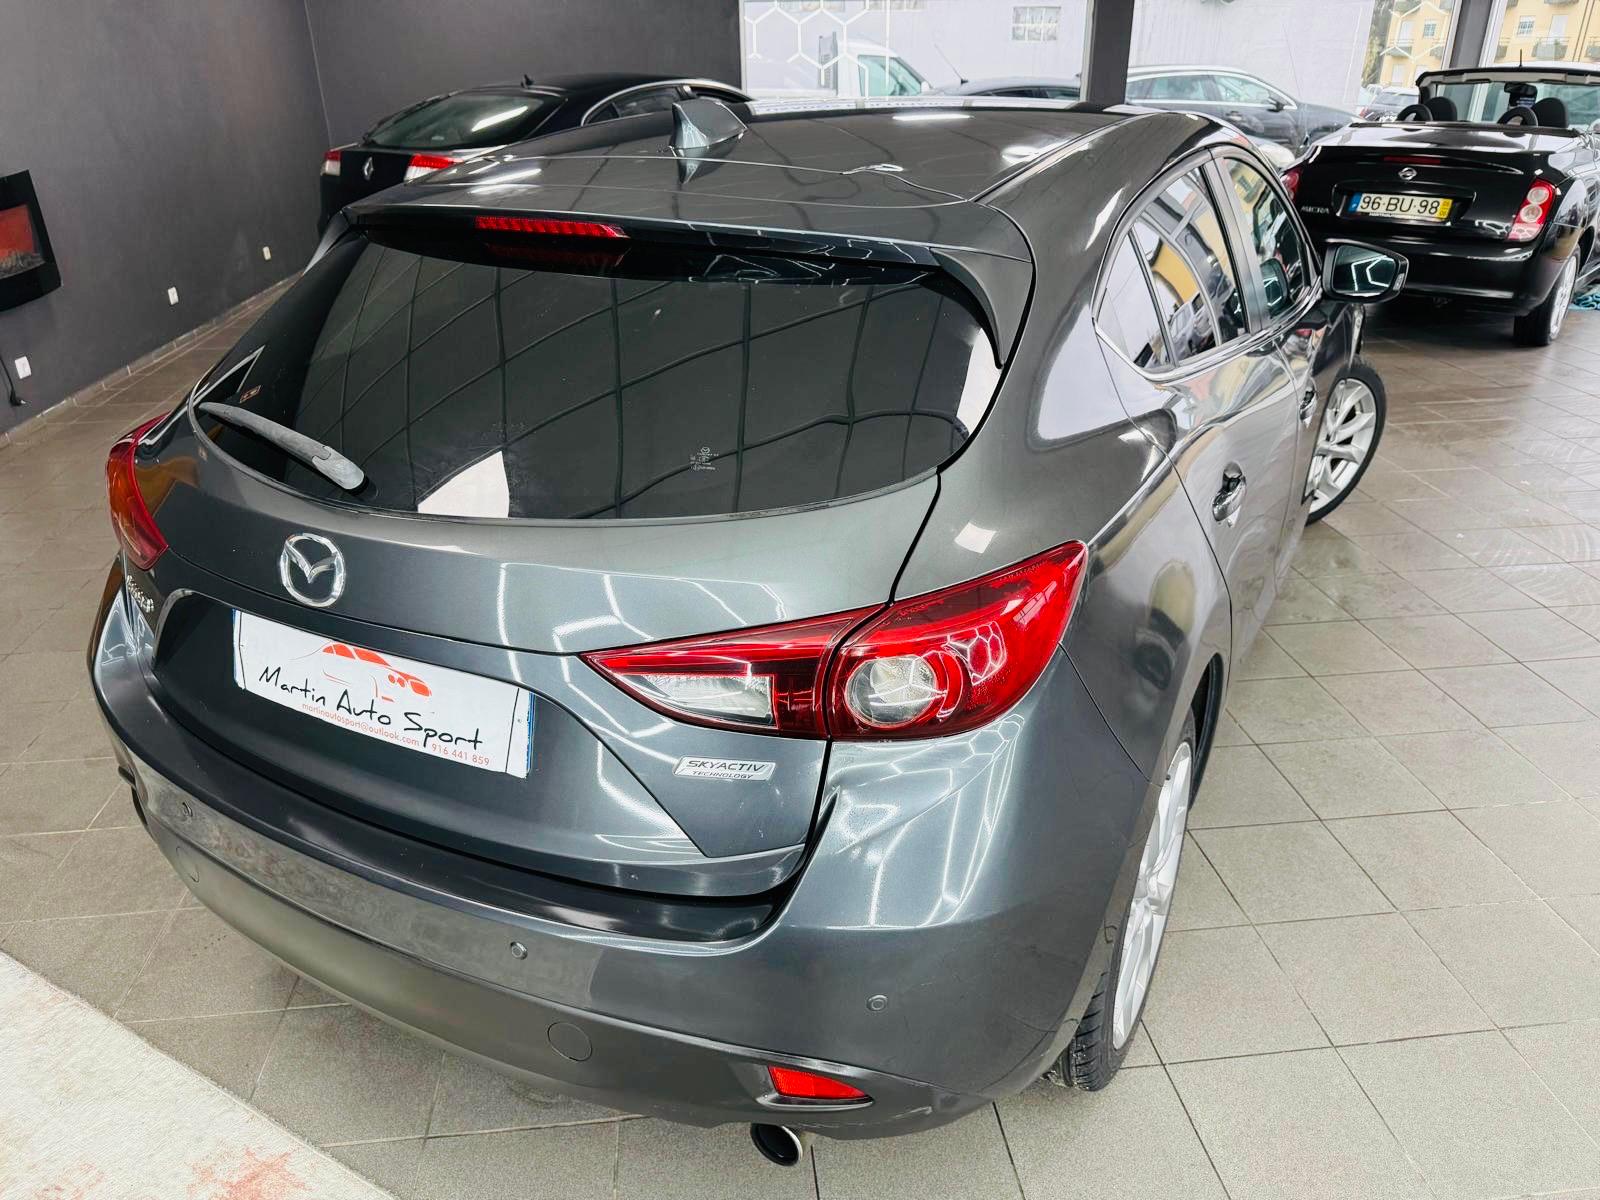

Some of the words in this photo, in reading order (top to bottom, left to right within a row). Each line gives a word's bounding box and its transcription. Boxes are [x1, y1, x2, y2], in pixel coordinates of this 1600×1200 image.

[259, 666, 326, 706] Martin
[336, 689, 392, 726] Auto
[403, 712, 483, 750] Sport
[431, 743, 449, 755] 916
[451, 749, 468, 760] 441
[472, 756, 490, 766] 859
[686, 760, 766, 772] SKYACTIV
[692, 770, 754, 779] TECHNOLOGY
